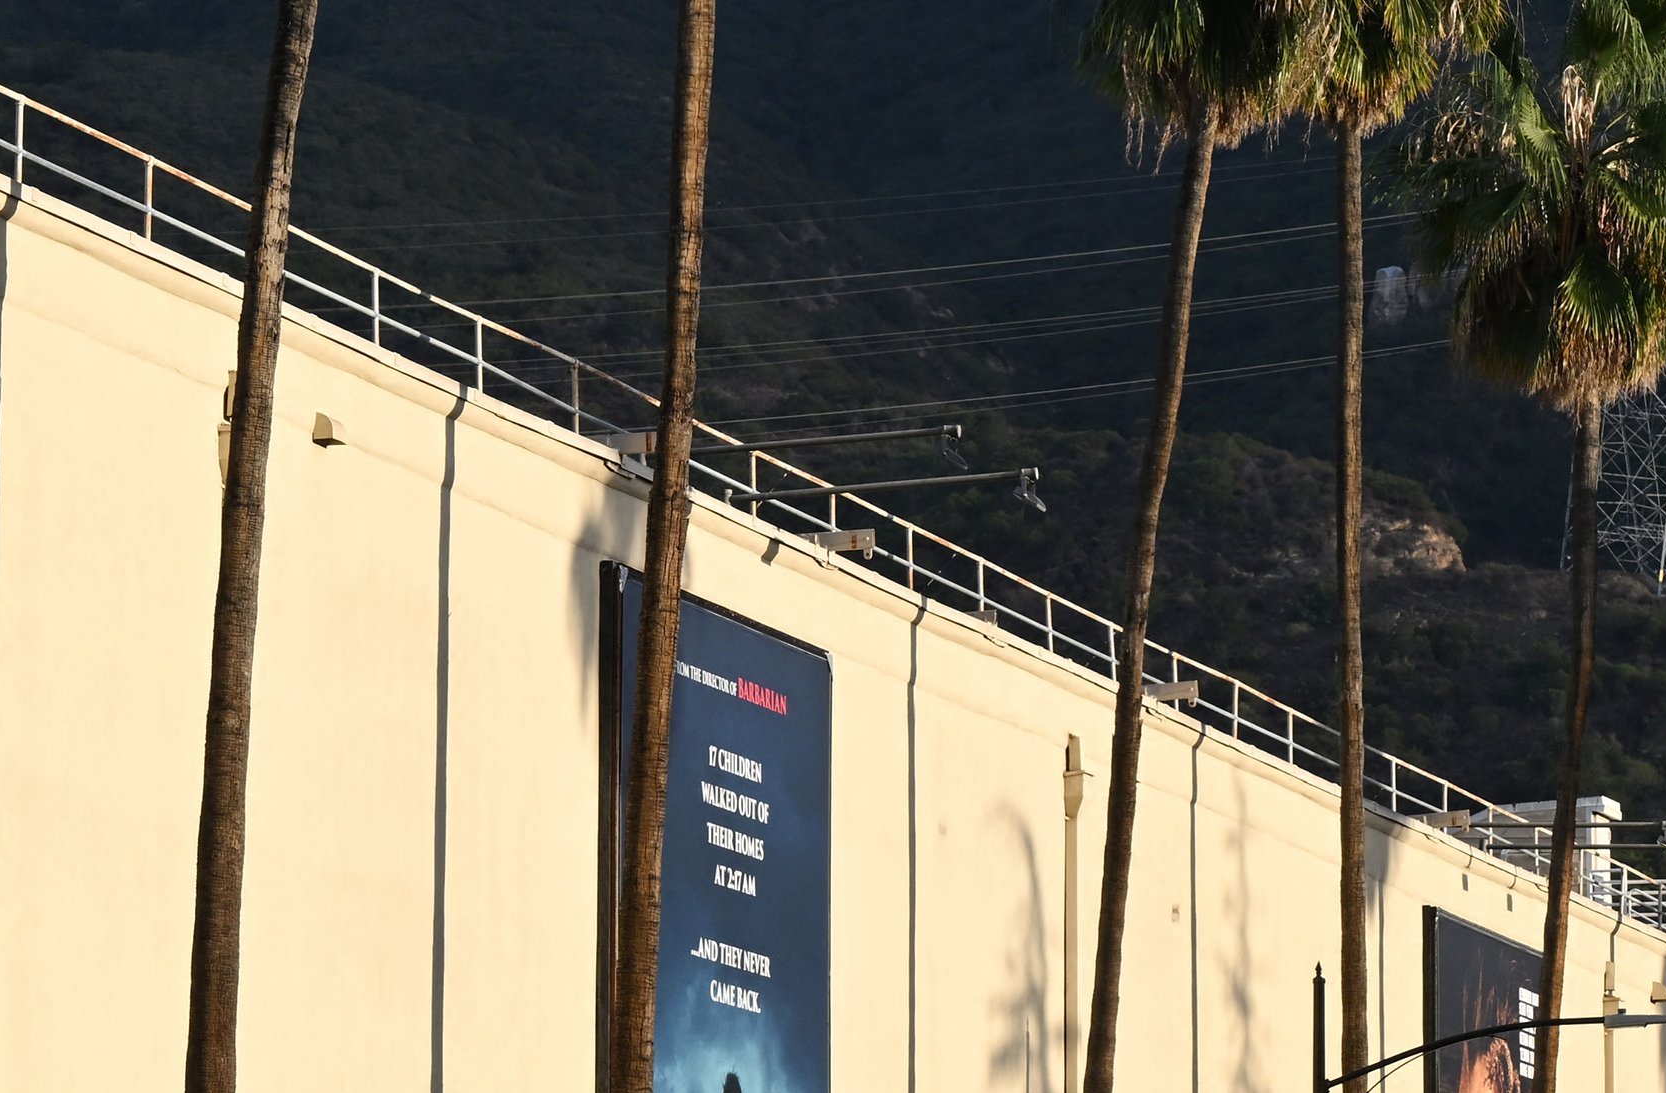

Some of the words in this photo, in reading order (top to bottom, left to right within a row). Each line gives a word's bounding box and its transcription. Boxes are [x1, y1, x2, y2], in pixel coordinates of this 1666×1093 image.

[675, 660, 690, 679] ROM
[690, 665, 702, 683] THE
[702, 670, 730, 694] DIRECTOR
[729, 680, 738, 697] OF
[738, 677, 787, 715] BARBARIAN
[708, 745, 718, 767] 17
[718, 748, 763, 784] CHILDREN
[701, 780, 738, 814] WALKED
[738, 794, 757, 820] OUT
[757, 802, 770, 824] OF
[706, 822, 734, 851] THEIR
[734, 831, 765, 861] HOMES
[714, 864, 727, 887] AT
[726, 867, 742, 891] 2:17
[741, 872, 757, 897] AM
[719, 942, 743, 969] THEY
[743, 950, 771, 978] NEVER
[710, 979, 736, 1007] CAME
[736, 986, 761, 1014] BACK.
